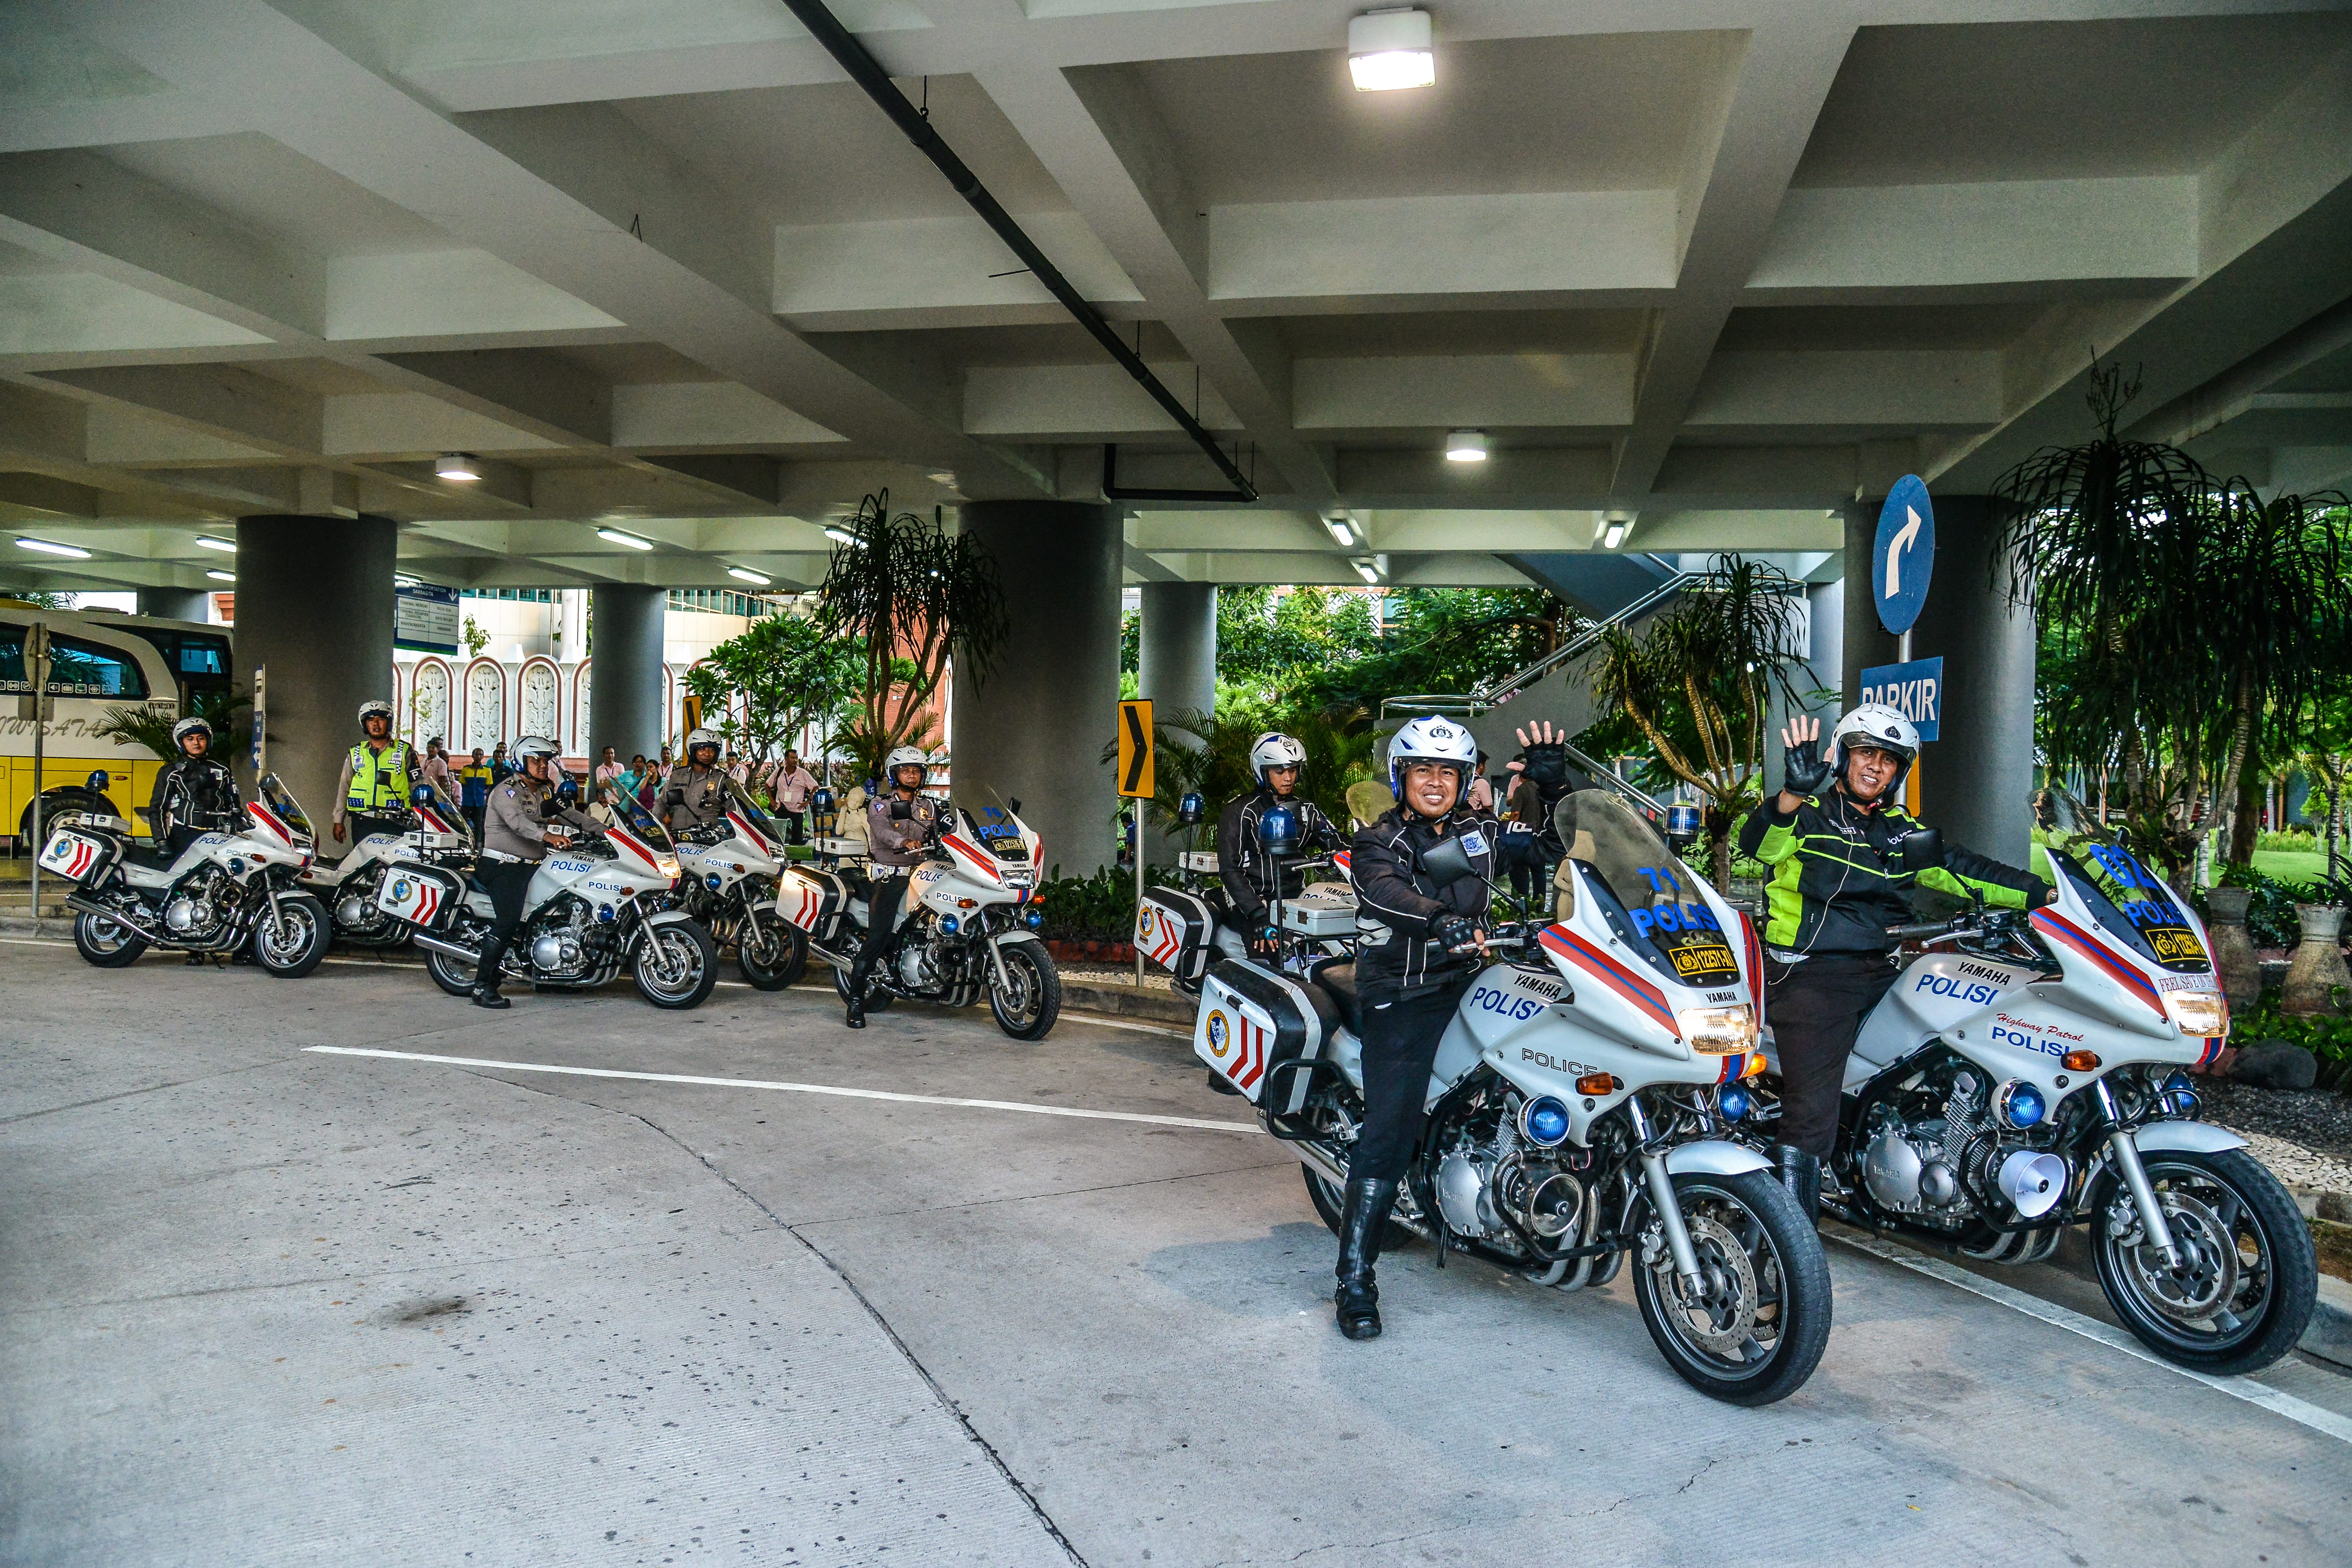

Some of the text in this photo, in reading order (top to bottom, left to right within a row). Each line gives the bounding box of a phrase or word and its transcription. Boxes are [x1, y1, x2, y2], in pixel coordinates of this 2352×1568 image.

[411, 771, 418, 780] P
[943, 816, 953, 826] P
[550, 861, 591, 873] POLISI
[571, 854, 595, 863] YAMAHA
[1637, 867, 1681, 891] 71
[1957, 962, 2011, 986] YAMAHA
[1514, 973, 1562, 999] YAMAHA
[1915, 974, 2000, 1006] POLISI
[2158, 977, 2182, 992] FEEL
[2180, 975, 2199, 989] SAVE
[1706, 991, 1737, 1003] YAMAHA
[1996, 1013, 2085, 1042] Highway Patrol
